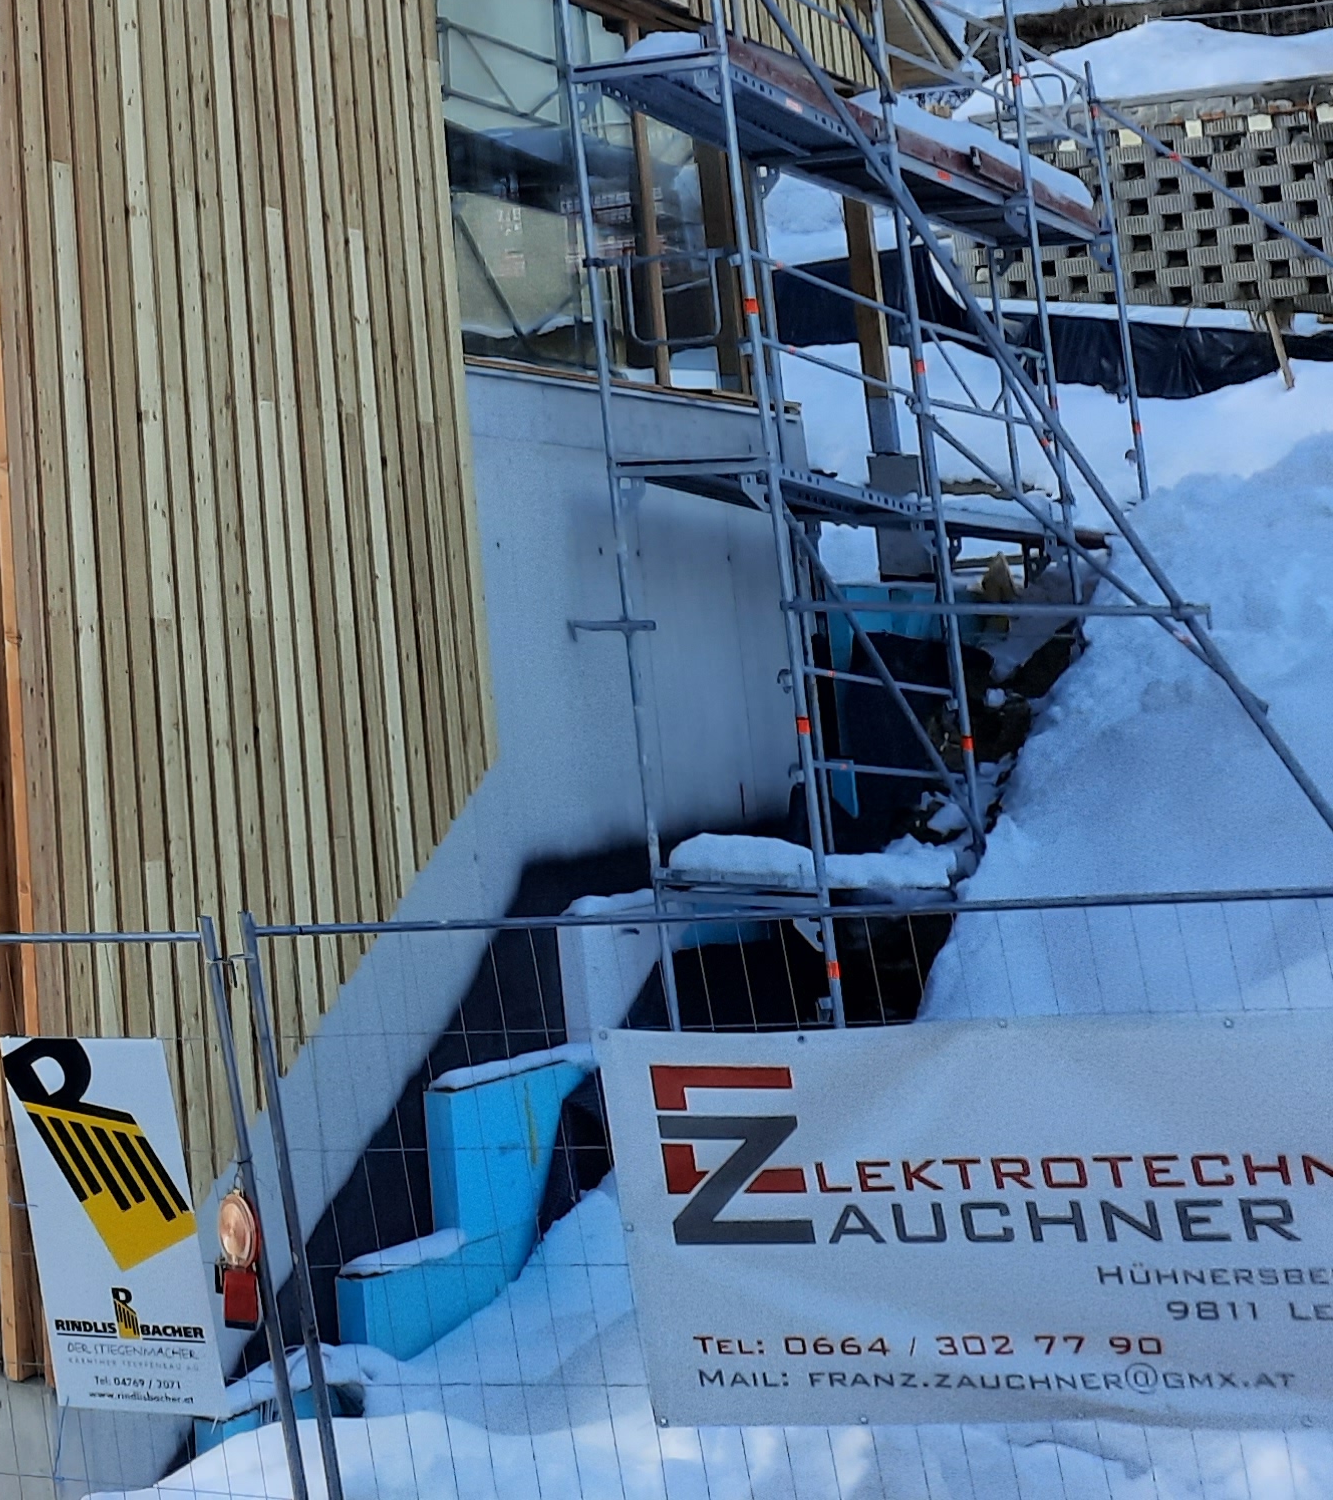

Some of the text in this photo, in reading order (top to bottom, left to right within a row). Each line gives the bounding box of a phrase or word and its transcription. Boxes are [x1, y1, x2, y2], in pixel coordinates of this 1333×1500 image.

[1167, 1301, 1259, 1320] 9811
[67, 1342, 200, 1360] DER STIEGENMACHER
[784, 1336, 891, 1356] 0664
[935, 1336, 1014, 1356] 302
[1035, 1335, 1085, 1355] 77
[1109, 1336, 1163, 1355] 90
